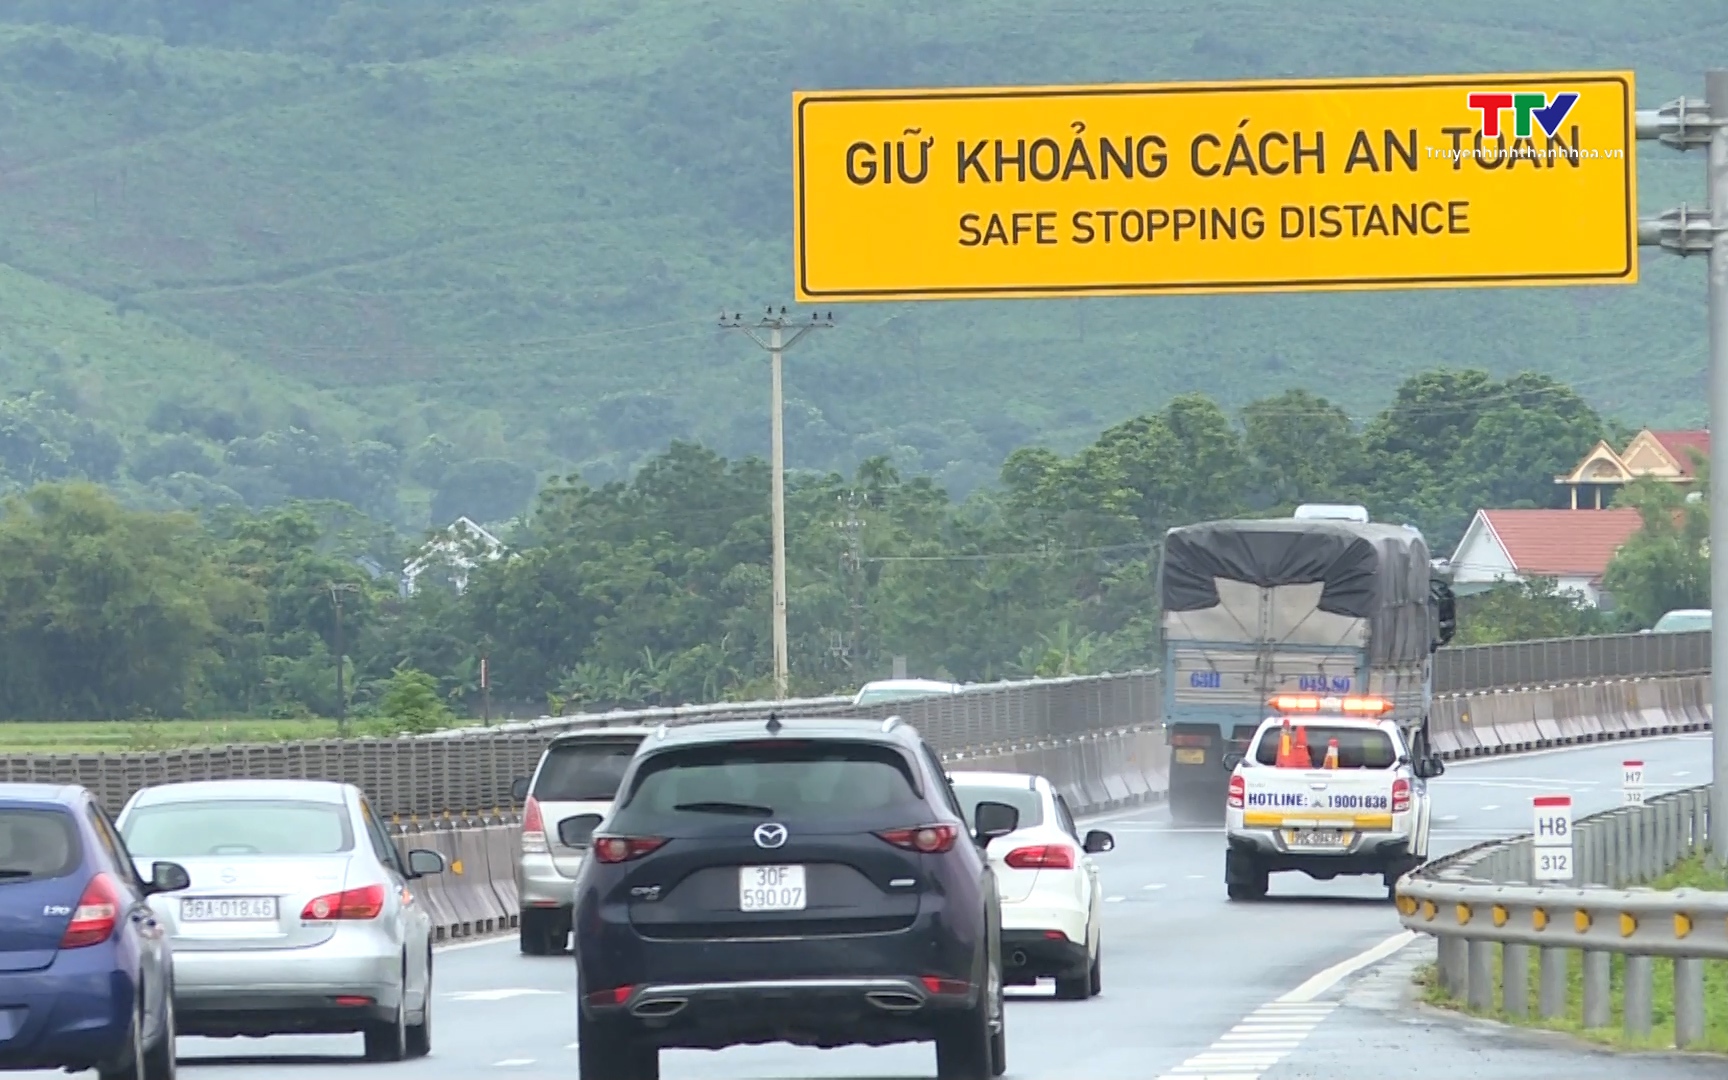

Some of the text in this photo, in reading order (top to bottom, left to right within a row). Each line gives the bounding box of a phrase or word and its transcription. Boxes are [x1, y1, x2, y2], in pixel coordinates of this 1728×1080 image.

[846, 127, 934, 186] GIỮ
[956, 121, 1168, 184] KHOẢNG
[1191, 119, 1325, 177] CÁCH
[1344, 128, 1418, 175] AN
[958, 200, 1471, 247] SAFE STOPPING DISTANCE
[1625, 771, 1642, 783] H7
[1249, 793, 1388, 809] HOTLINE: 19001838
[1539, 816, 1568, 836] H8
[1541, 854, 1568, 871] 312
[756, 866, 790, 886] 30F
